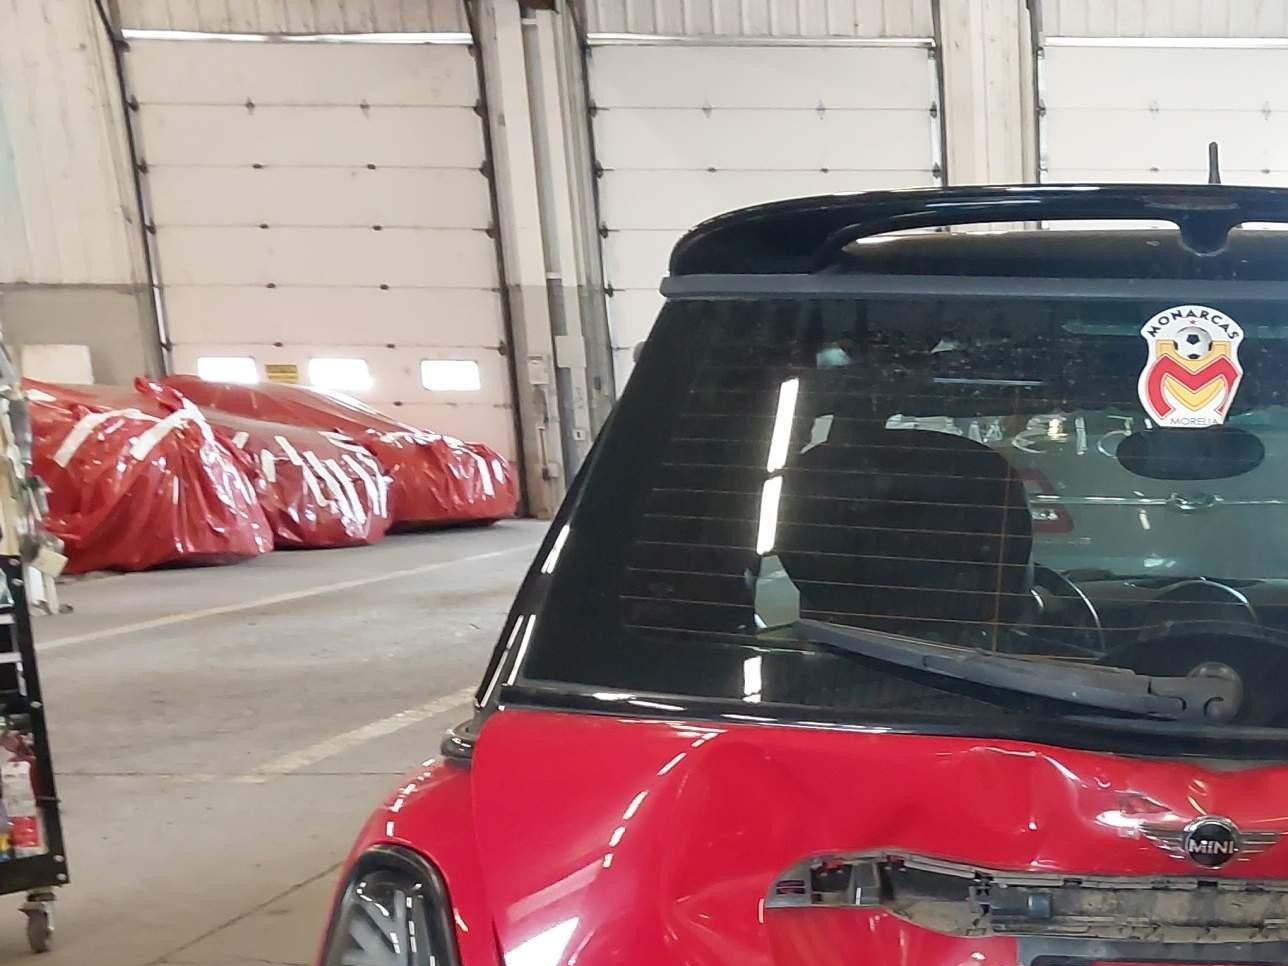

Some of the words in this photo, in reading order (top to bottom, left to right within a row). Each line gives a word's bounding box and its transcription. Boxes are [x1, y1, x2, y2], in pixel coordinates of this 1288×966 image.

[1147, 310, 1239, 339] MONARCAS
[1170, 417, 1218, 425] MORELIA
[1189, 839, 1234, 854] MINI
